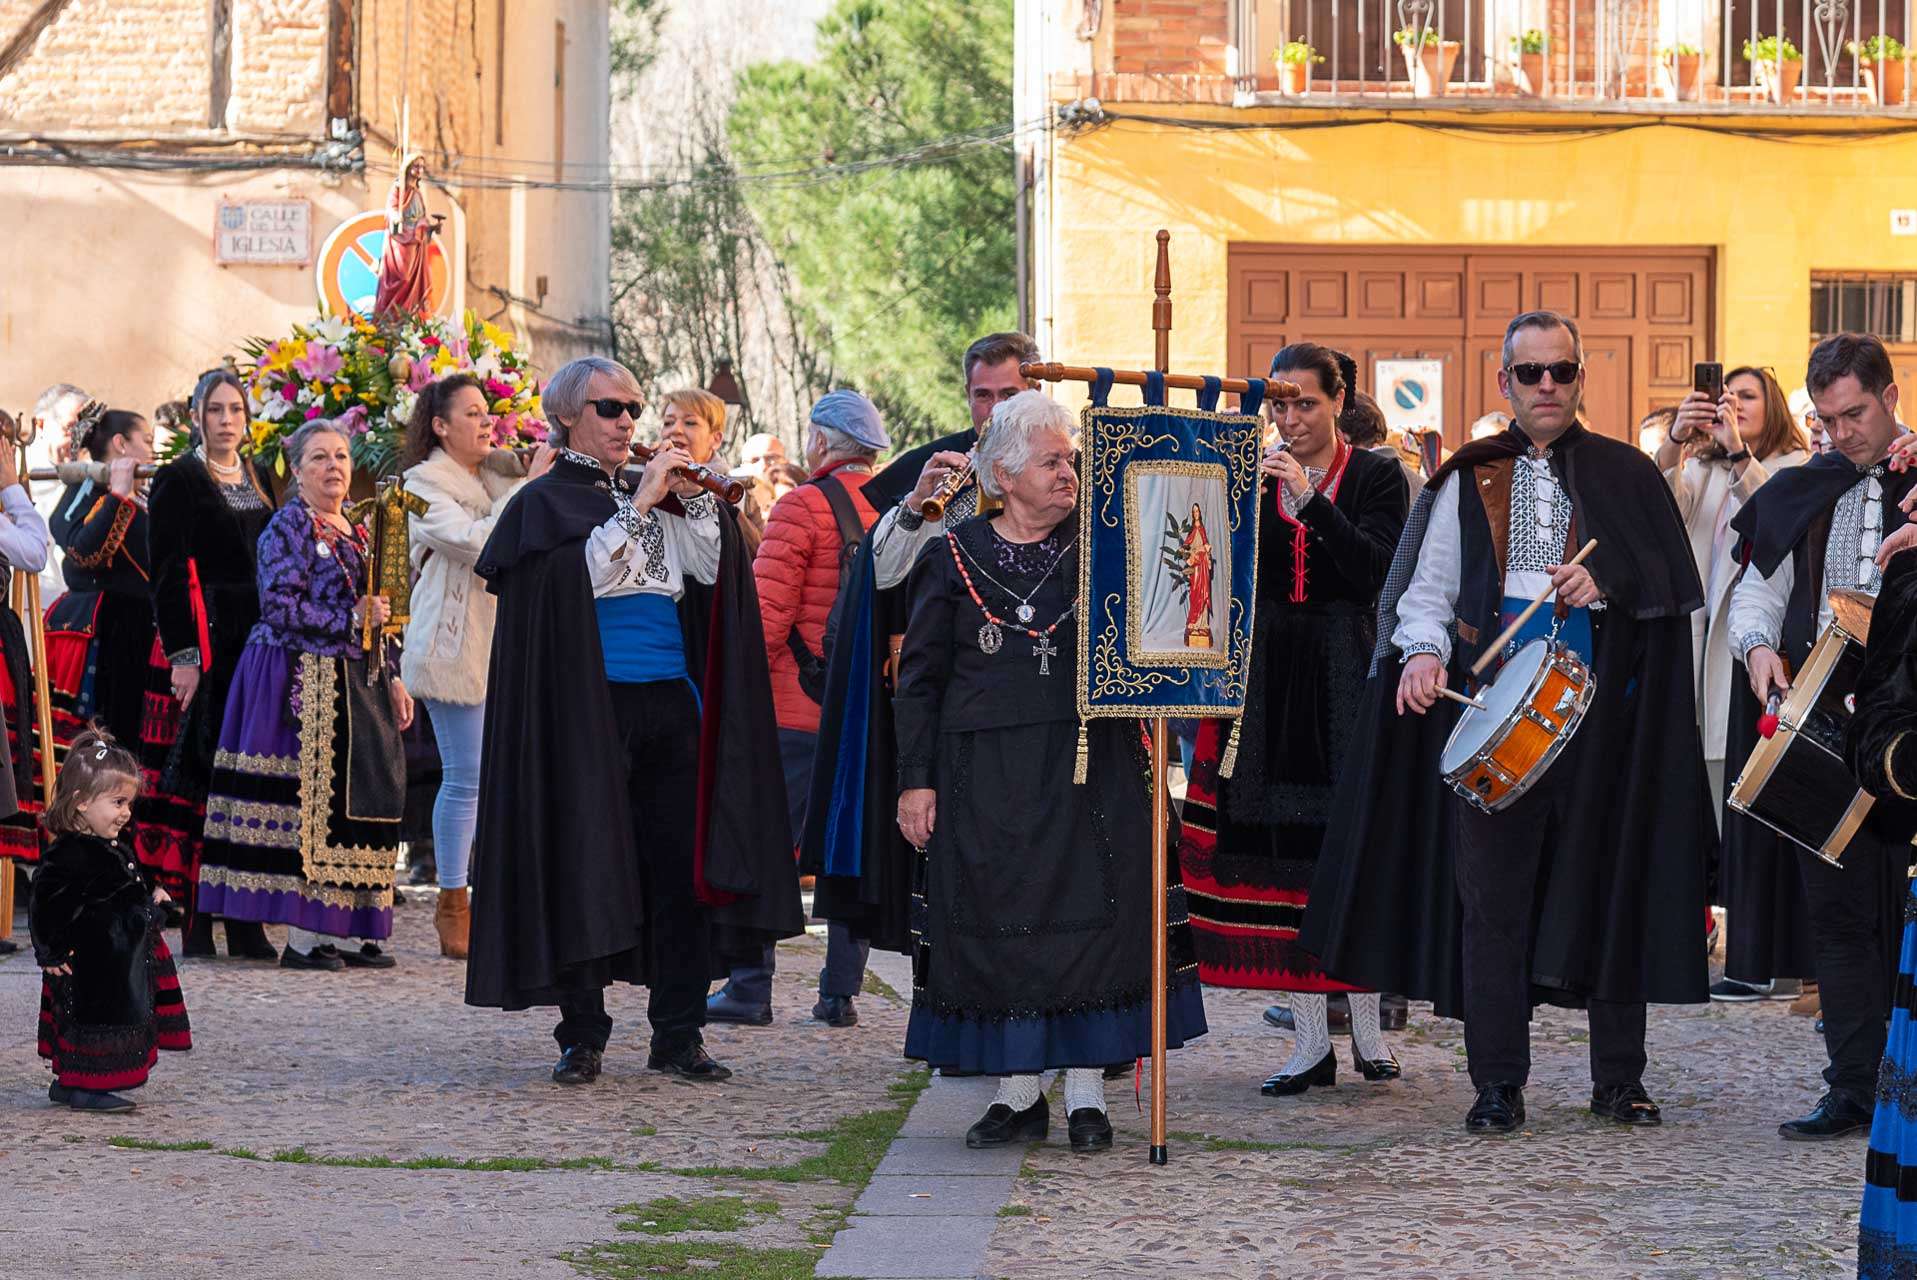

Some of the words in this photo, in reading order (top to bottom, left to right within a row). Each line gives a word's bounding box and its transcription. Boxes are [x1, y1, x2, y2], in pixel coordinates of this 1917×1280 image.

[250, 209, 299, 221] CALLE
[250, 222, 267, 231] DE
[273, 222, 294, 232] LA
[232, 236, 297, 254] IGLESIA
[846, 463, 870, 472] Can
